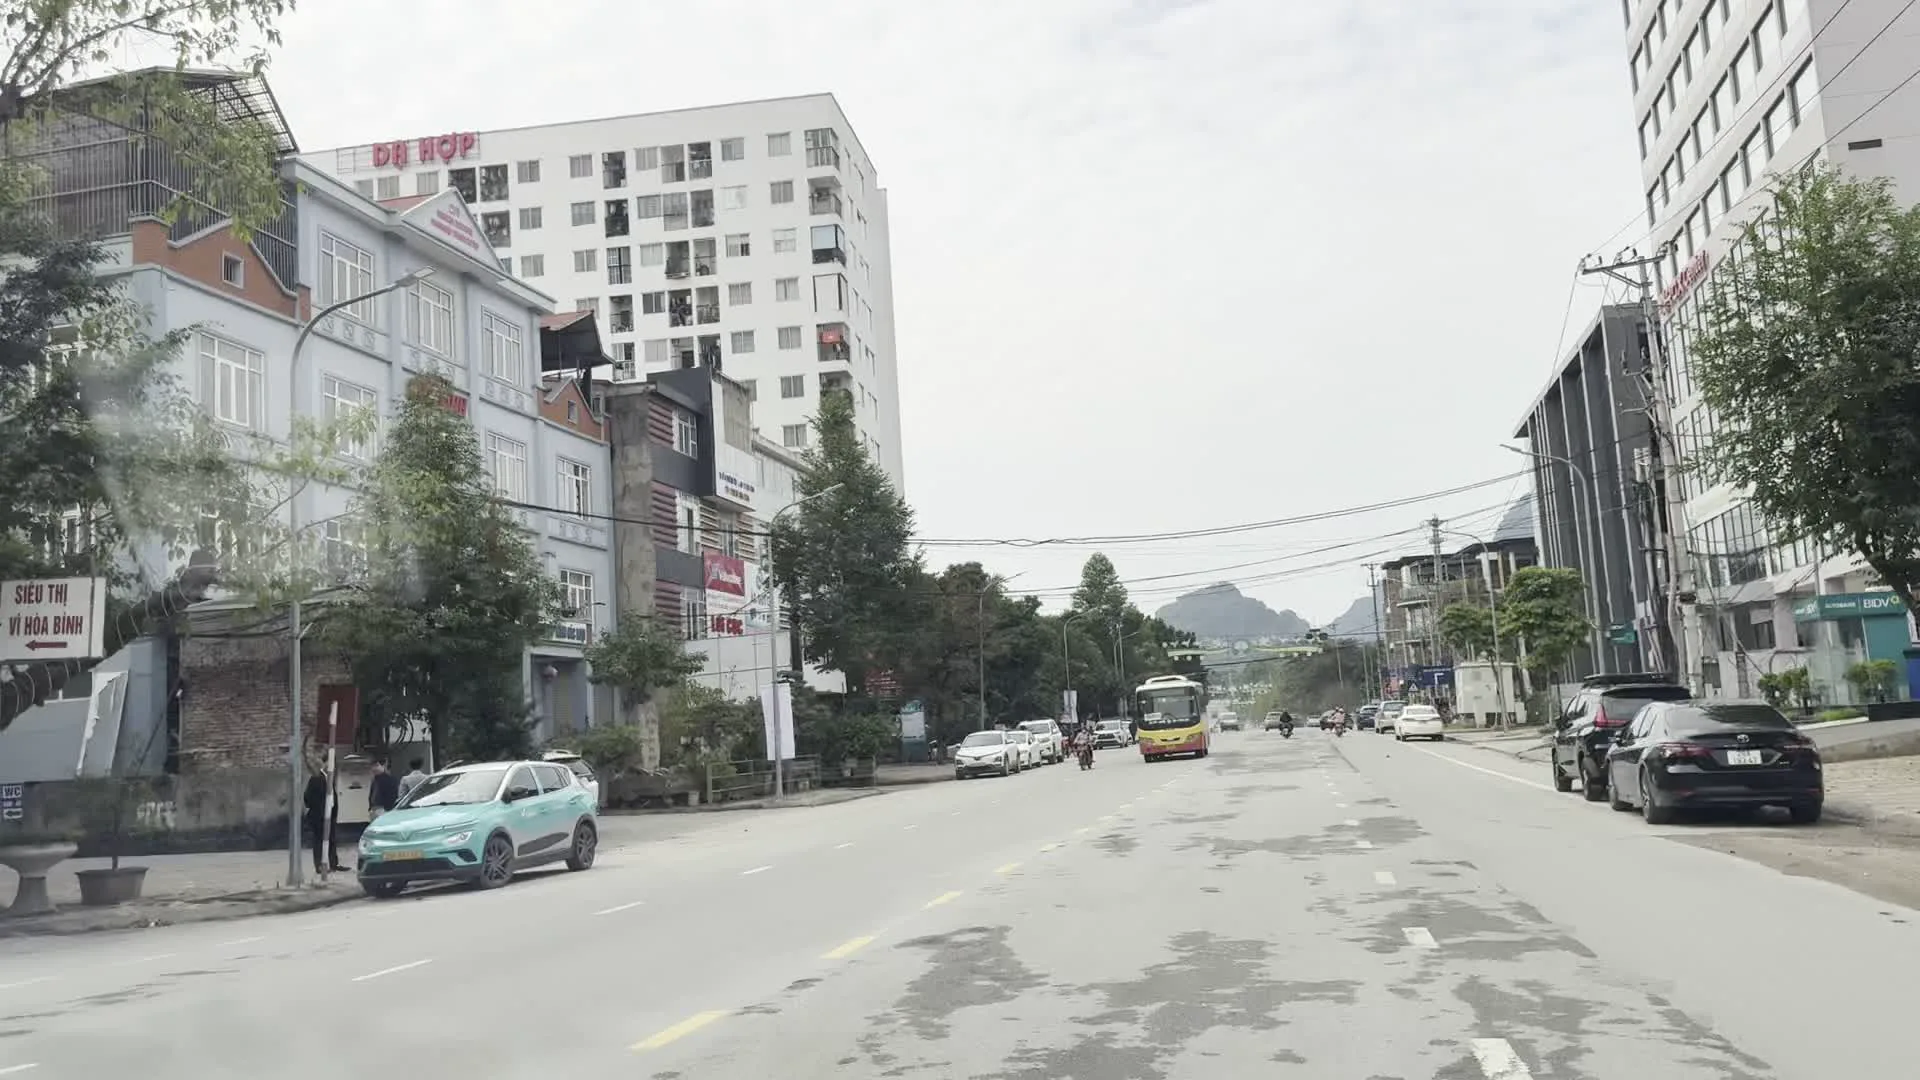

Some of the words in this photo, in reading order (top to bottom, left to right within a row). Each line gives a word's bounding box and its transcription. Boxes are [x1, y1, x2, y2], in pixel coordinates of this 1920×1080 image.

[373, 141, 408, 170] DẠ
[419, 132, 475, 164] HỢP
[15, 581, 43, 604] SIÊU
[48, 583, 68, 607] THỊ
[1863, 598, 1890, 609] BIDV
[24, 612, 49, 636] HÒA
[53, 612, 84, 636] BÌNH
